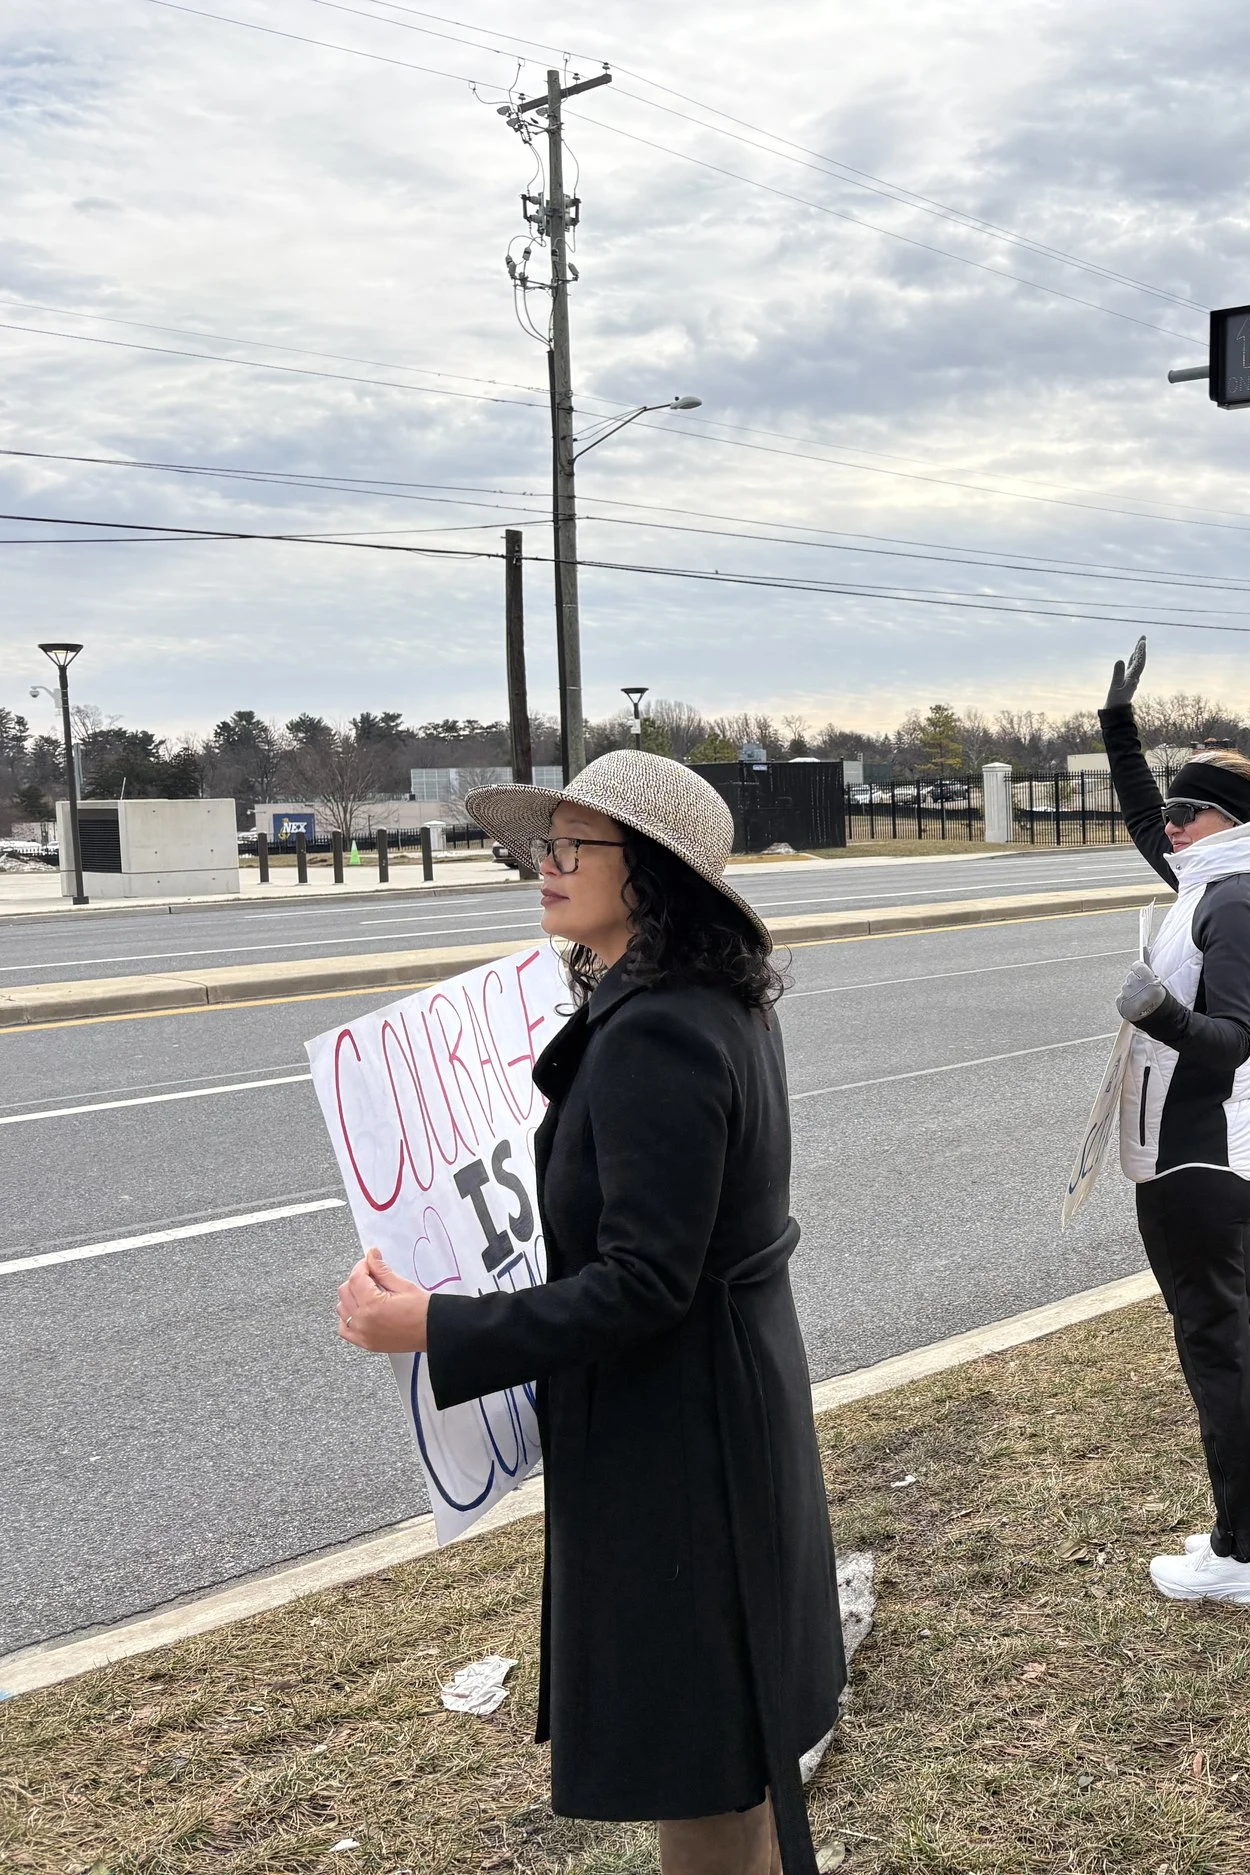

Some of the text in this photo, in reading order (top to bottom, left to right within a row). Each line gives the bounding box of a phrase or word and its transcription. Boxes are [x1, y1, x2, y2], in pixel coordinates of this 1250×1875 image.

[282, 821, 307, 834] NEX
[334, 950, 551, 1213] COURAGE
[452, 1139, 535, 1274] IS
